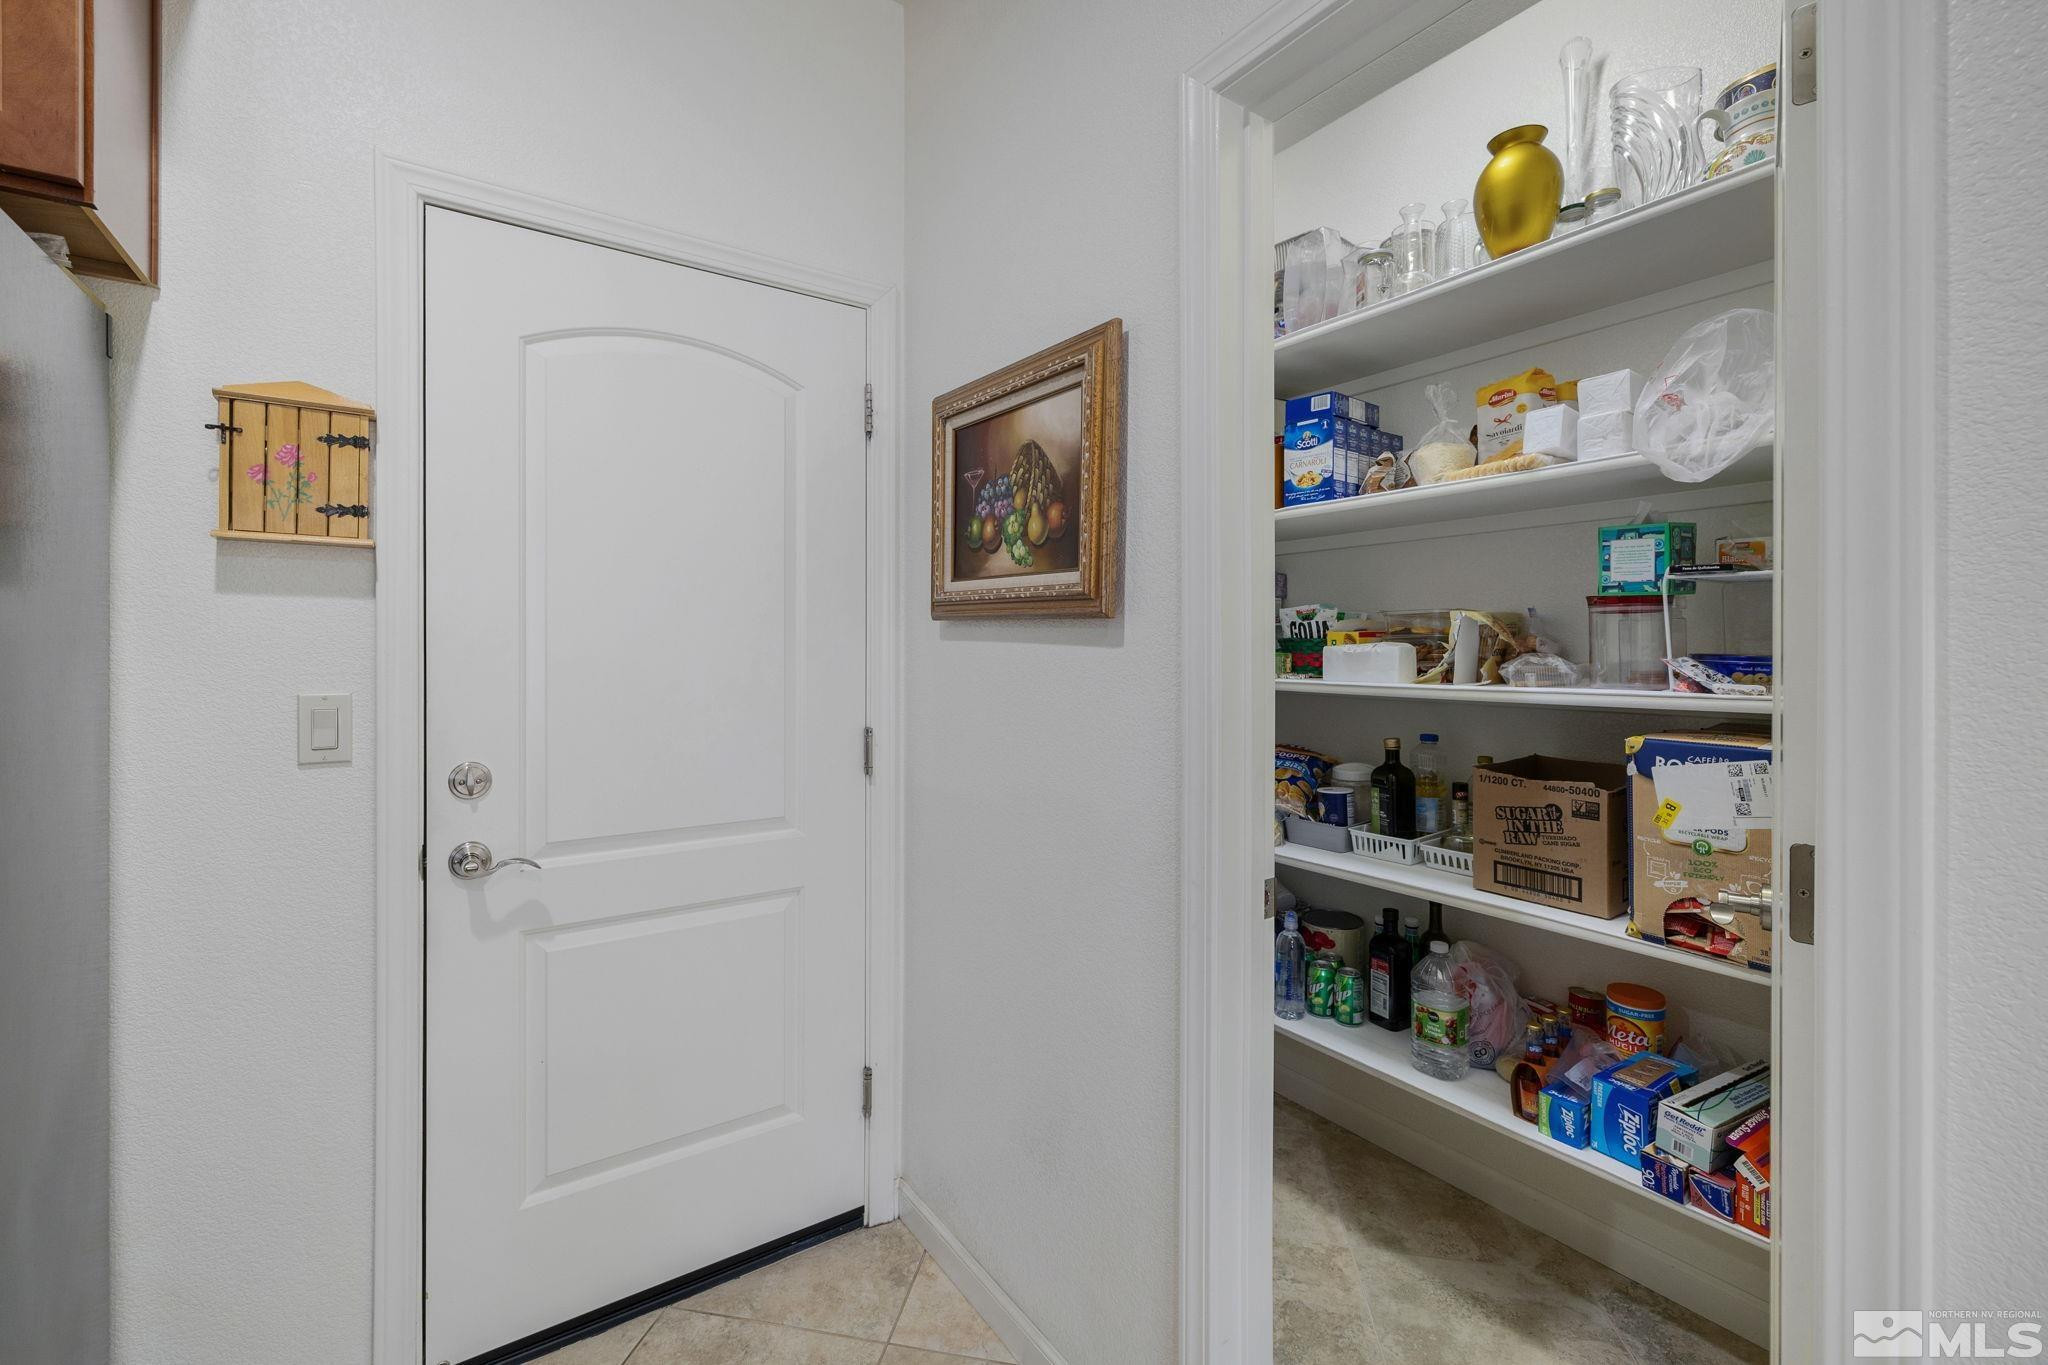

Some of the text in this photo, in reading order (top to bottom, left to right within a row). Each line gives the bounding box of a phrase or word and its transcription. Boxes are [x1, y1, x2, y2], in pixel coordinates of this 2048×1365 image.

[1479, 774, 1508, 787] 1/1200
[1511, 779, 1527, 789] CT.
[1495, 806, 1550, 821] SUGAR
[1507, 819, 1564, 835] IN THE
[1503, 831, 1540, 846] RAW
[1561, 1106, 1575, 1138] Ziploc
[1664, 1110, 1679, 1121] Get
[1618, 1108, 1639, 1156] Ziploc
